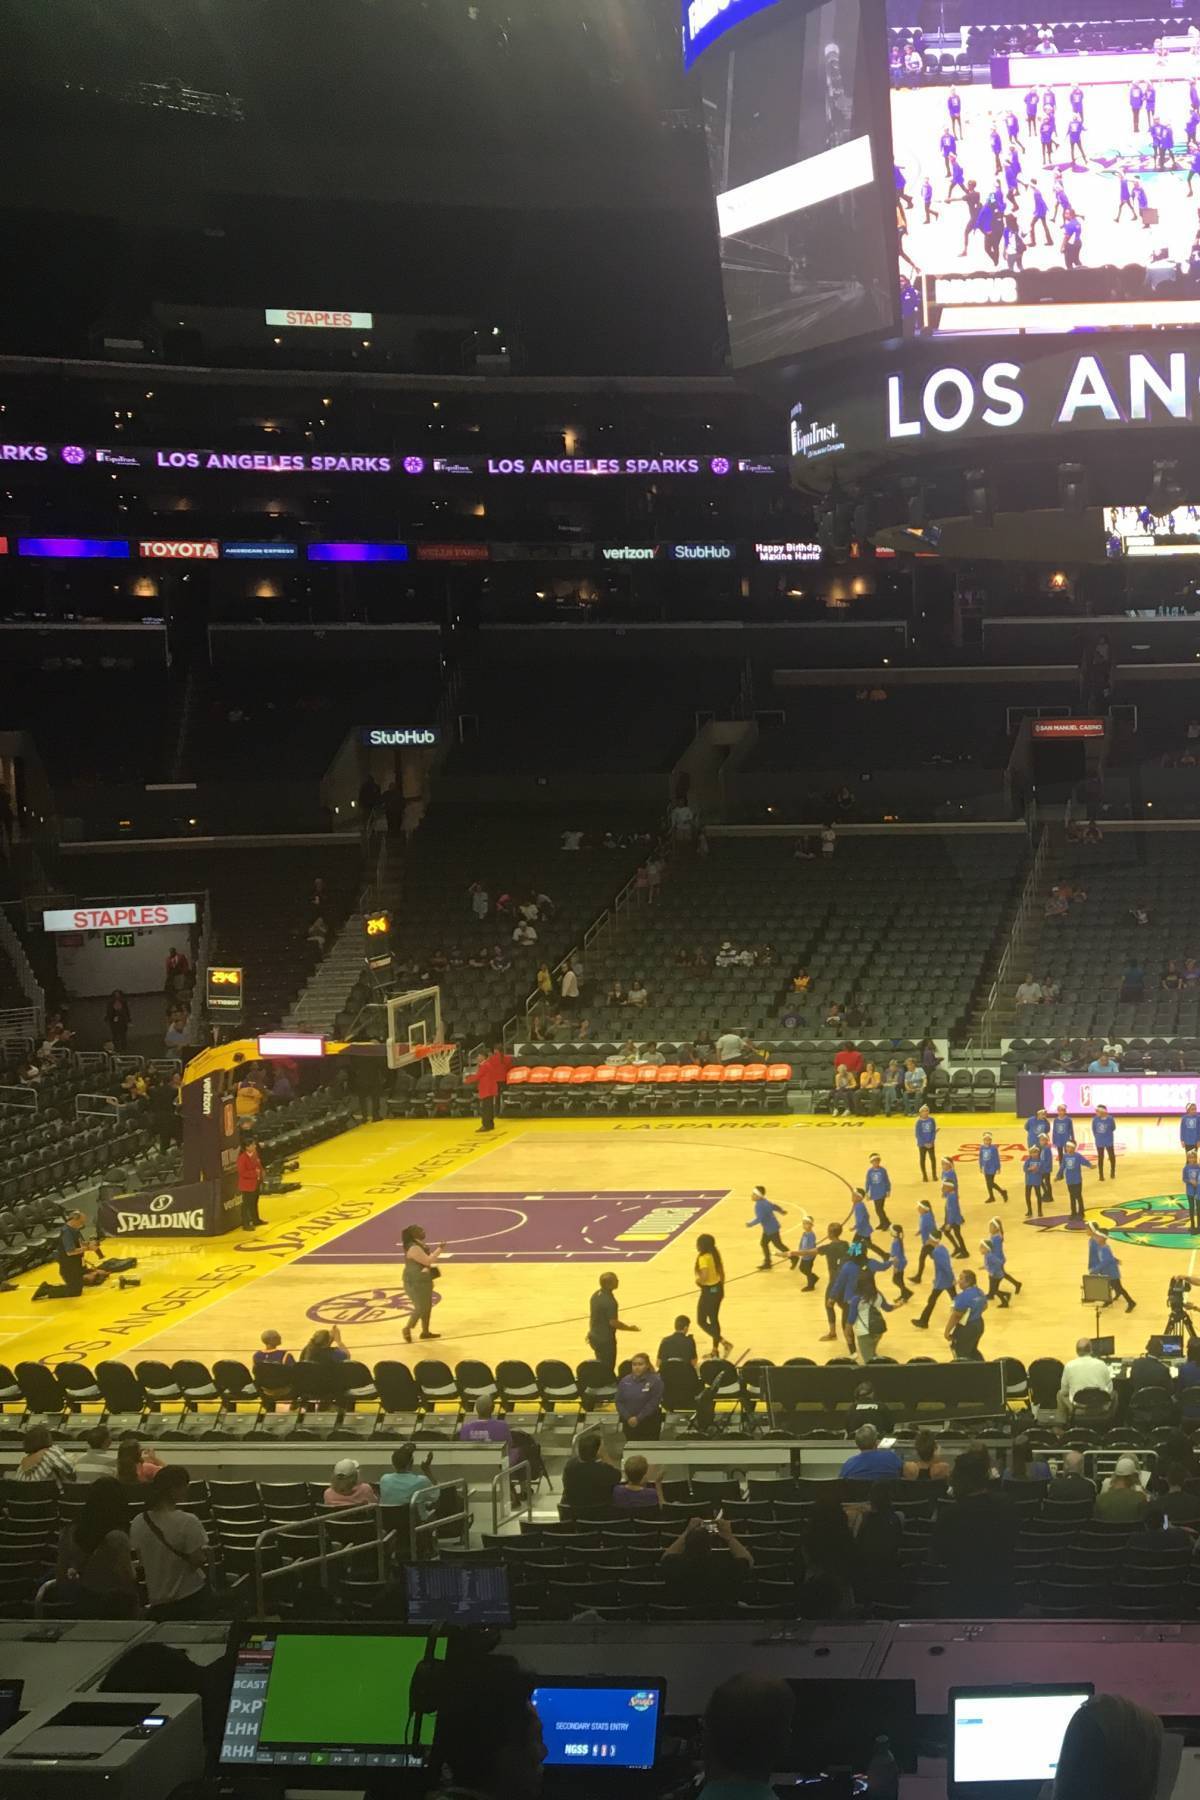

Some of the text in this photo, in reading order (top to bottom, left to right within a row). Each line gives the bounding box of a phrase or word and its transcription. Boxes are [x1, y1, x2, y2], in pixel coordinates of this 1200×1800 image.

[287, 312, 353, 326] STAPLES
[888, 361, 1025, 438] LOS
[157, 451, 391, 472] LOS ANGELES SPARKS
[488, 458, 699, 474] LOS ANGELES SPARKS
[140, 542, 217, 558] TOYOTA
[603, 547, 655, 559] verizon
[675, 545, 730, 558] StubHub
[755, 543, 822, 554] Happy Birthday
[760, 552, 820, 560] Maxine Harris
[370, 729, 435, 745] StubHub
[73, 907, 169, 928] STAPLES
[105, 934, 132, 946] EXIT
[203, 1077, 214, 1115] verizon
[116, 1209, 205, 1233] SPALDING
[98, 1264, 257, 1336] ANGELES
[233, 1199, 375, 1258] SPARKS
[233, 1680, 267, 1689] BCAST
[230, 1699, 263, 1713] PxP
[225, 1722, 258, 1735] LHH
[556, 1722, 629, 1731] SECONDARY STATS ENTRY
[221, 1745, 254, 1757] RHH
[565, 1744, 589, 1755] NGSS
